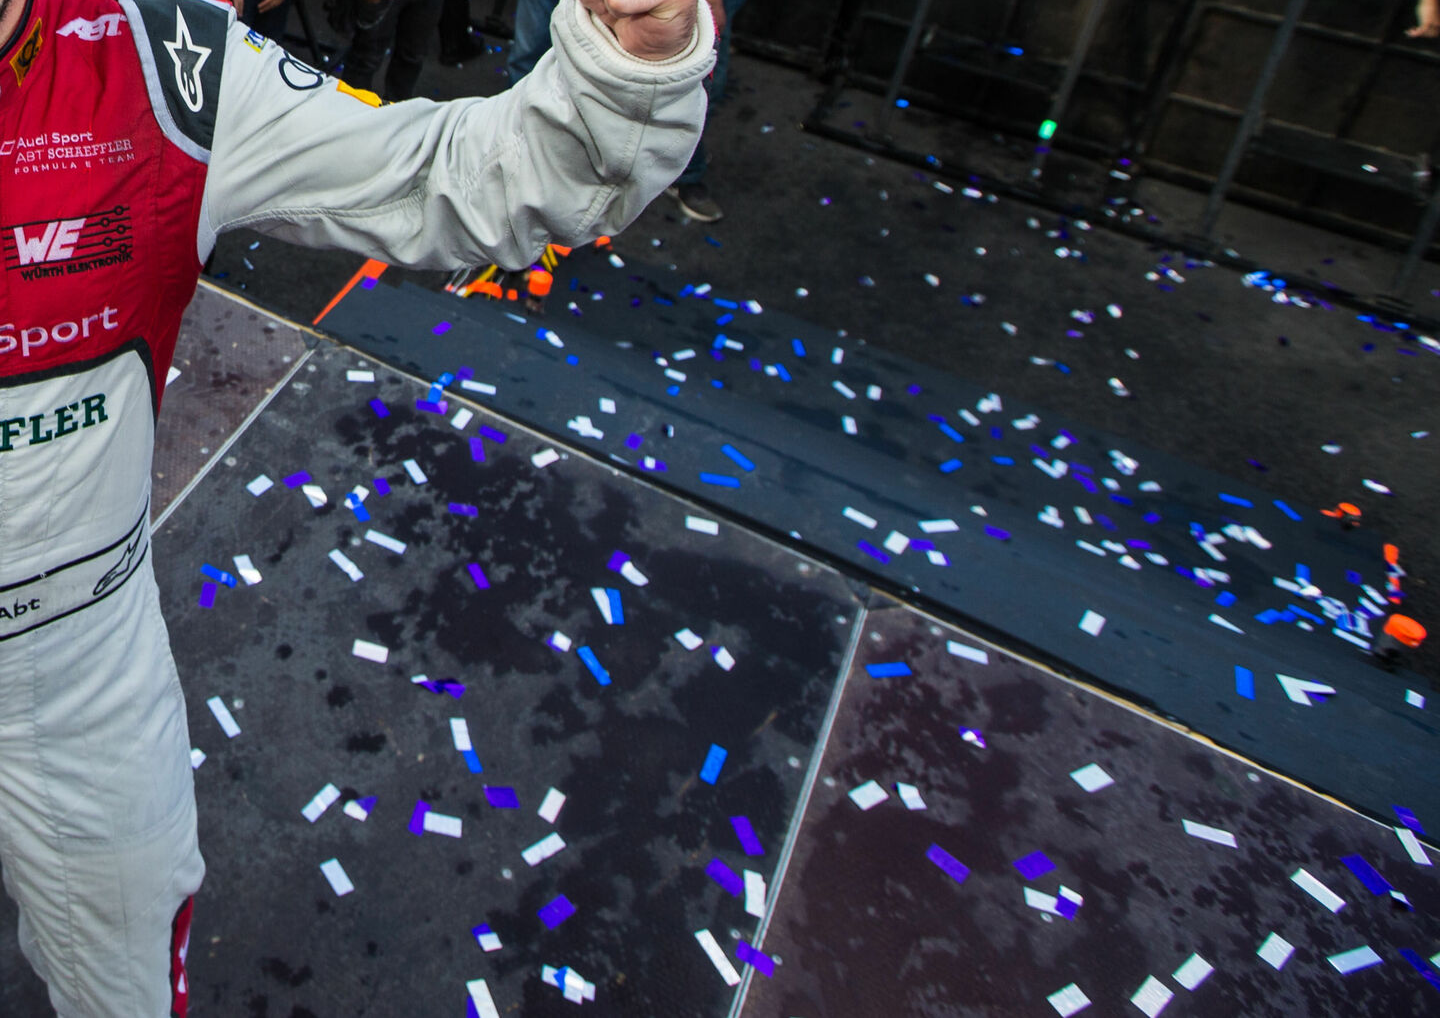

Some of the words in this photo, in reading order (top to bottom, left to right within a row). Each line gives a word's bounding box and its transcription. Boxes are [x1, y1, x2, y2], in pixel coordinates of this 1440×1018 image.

[56, 13, 129, 41] ABT
[16, 150, 45, 164] ABT
[48, 138, 134, 160] SCHAEFFLER
[17, 134, 48, 149] Audi
[52, 131, 93, 146] Sport
[14, 161, 78, 175] FORMULA
[100, 153, 135, 165] TEAM
[13, 217, 88, 267] WE
[21, 263, 64, 281] WÜRTH
[67, 251, 134, 274] ELEKTRONIK
